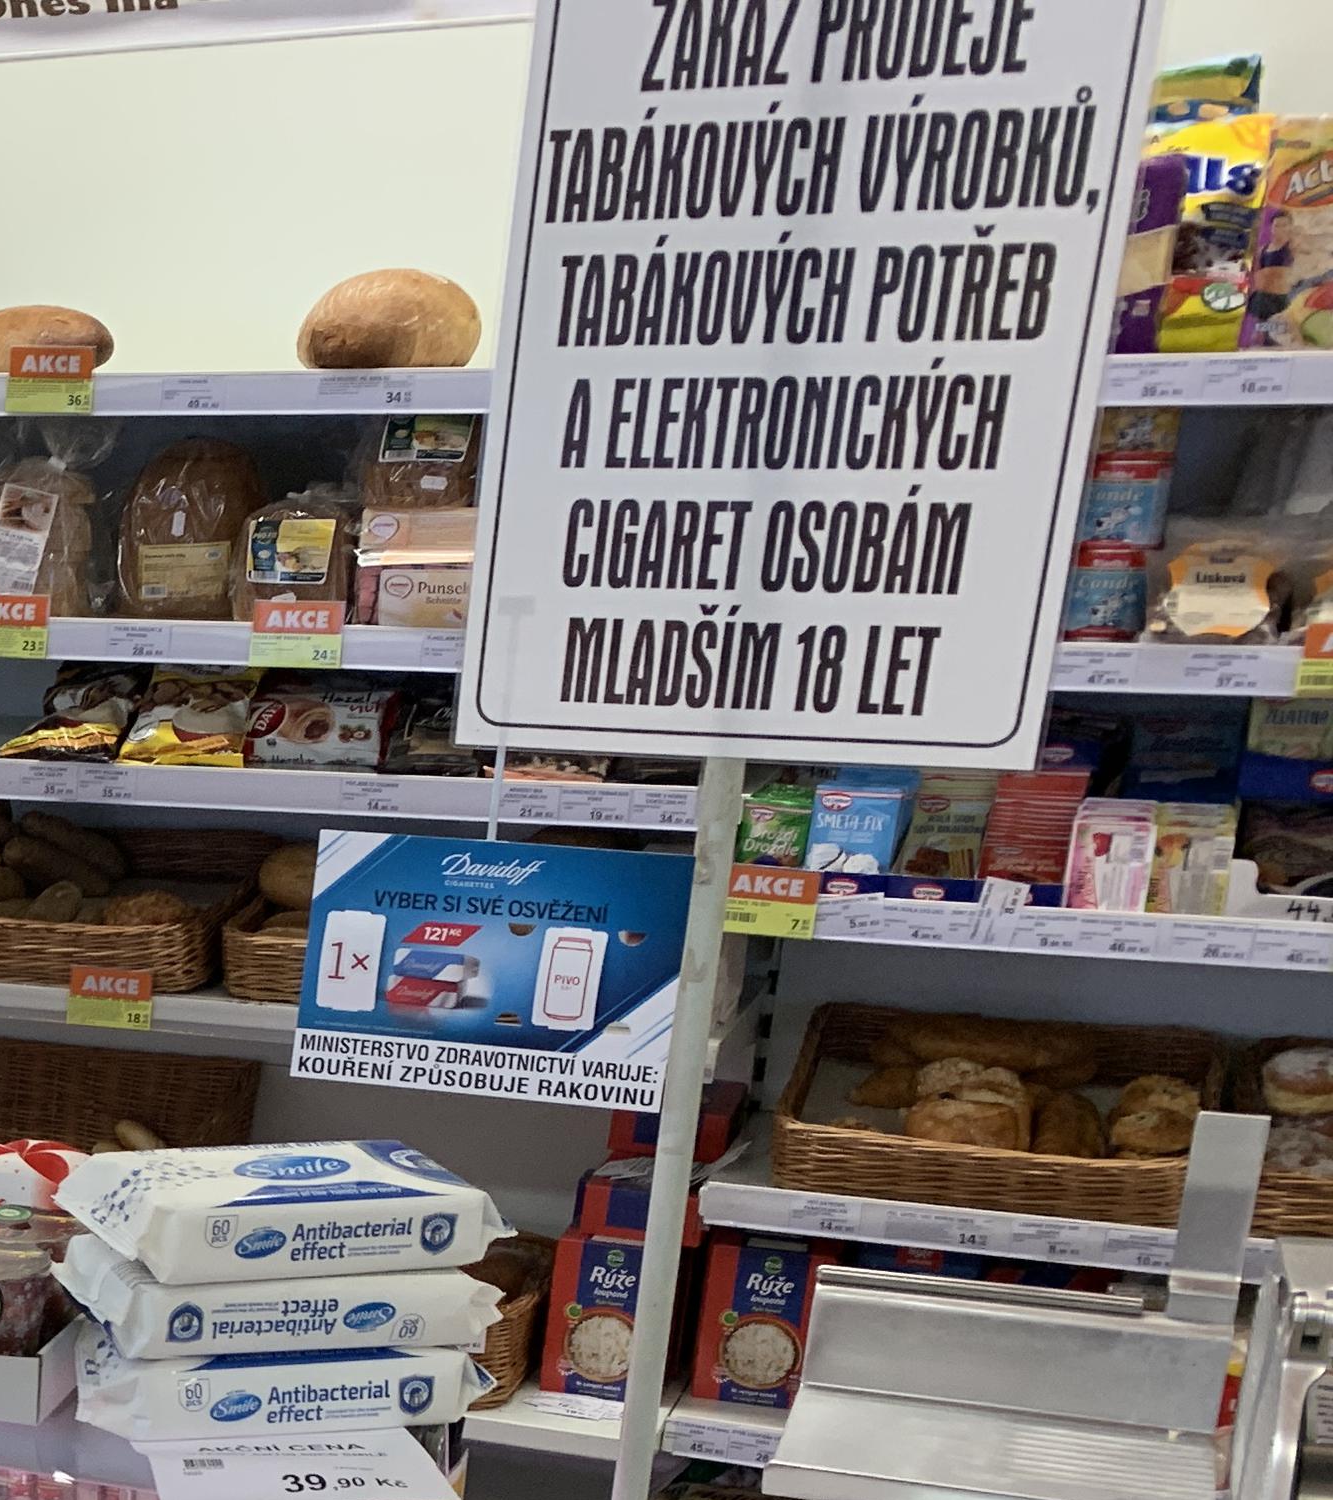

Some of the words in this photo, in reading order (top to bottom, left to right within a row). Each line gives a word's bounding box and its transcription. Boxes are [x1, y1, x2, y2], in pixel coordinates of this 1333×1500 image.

[545, 102, 846, 224] TABÁKOVÝCH
[859, 86, 1100, 214] VÝROBKŮ,
[557, 231, 855, 348] TABÁKOVÝCH
[865, 225, 1058, 343] POTŘEB
[20, 354, 82, 375] AKCE
[66, 394, 82, 407] 36
[385, 391, 403, 403] 34
[560, 377, 590, 468] A
[604, 357, 1012, 470] ELEKTRONICKÝCH
[562, 499, 752, 589] CIGARET
[761, 485, 972, 594] OSOBÁM
[265, 609, 330, 630] AKCE
[21, 640, 37, 652] 23
[312, 649, 328, 661] 24
[560, 604, 783, 711] MLADŠÍM
[795, 626, 847, 713] 18
[857, 626, 942, 717] LET
[441, 853, 546, 885] Davidoff
[734, 873, 806, 898] AKCE
[373, 888, 437, 912] VYBER
[444, 895, 461, 914] SI
[466, 894, 504, 917] SVÉ
[508, 899, 609, 925] OSVĚŽENÍ
[424, 926, 448, 942] 121
[81, 975, 141, 996] AKCE
[299, 1033, 430, 1063] MINISTERSTVO
[435, 1049, 578, 1076] ZDRAVOTNICTVÍ
[582, 1061, 659, 1085] VARUJE:
[297, 1055, 392, 1082] KOUŘENÍ
[400, 1064, 530, 1096] ZPŮSOBUJE
[537, 1079, 656, 1107] RAKOVINU
[246, 1157, 342, 1178] Smile
[212, 1219, 230, 1236] 60
[292, 1218, 414, 1242] Antibacterial
[290, 1241, 346, 1262] effect
[589, 1264, 637, 1289] Rýže
[745, 1270, 796, 1296] Rýže
[282, 1299, 339, 1318] effect
[212, 1317, 338, 1340] Antibacterial
[185, 1383, 202, 1400] 60
[267, 1379, 391, 1406] Antibacterial
[213, 1398, 259, 1418] Smile
[267, 1405, 323, 1424] effect
[282, 1473, 366, 1494] 39,90
[375, 1477, 409, 1489] Kč
